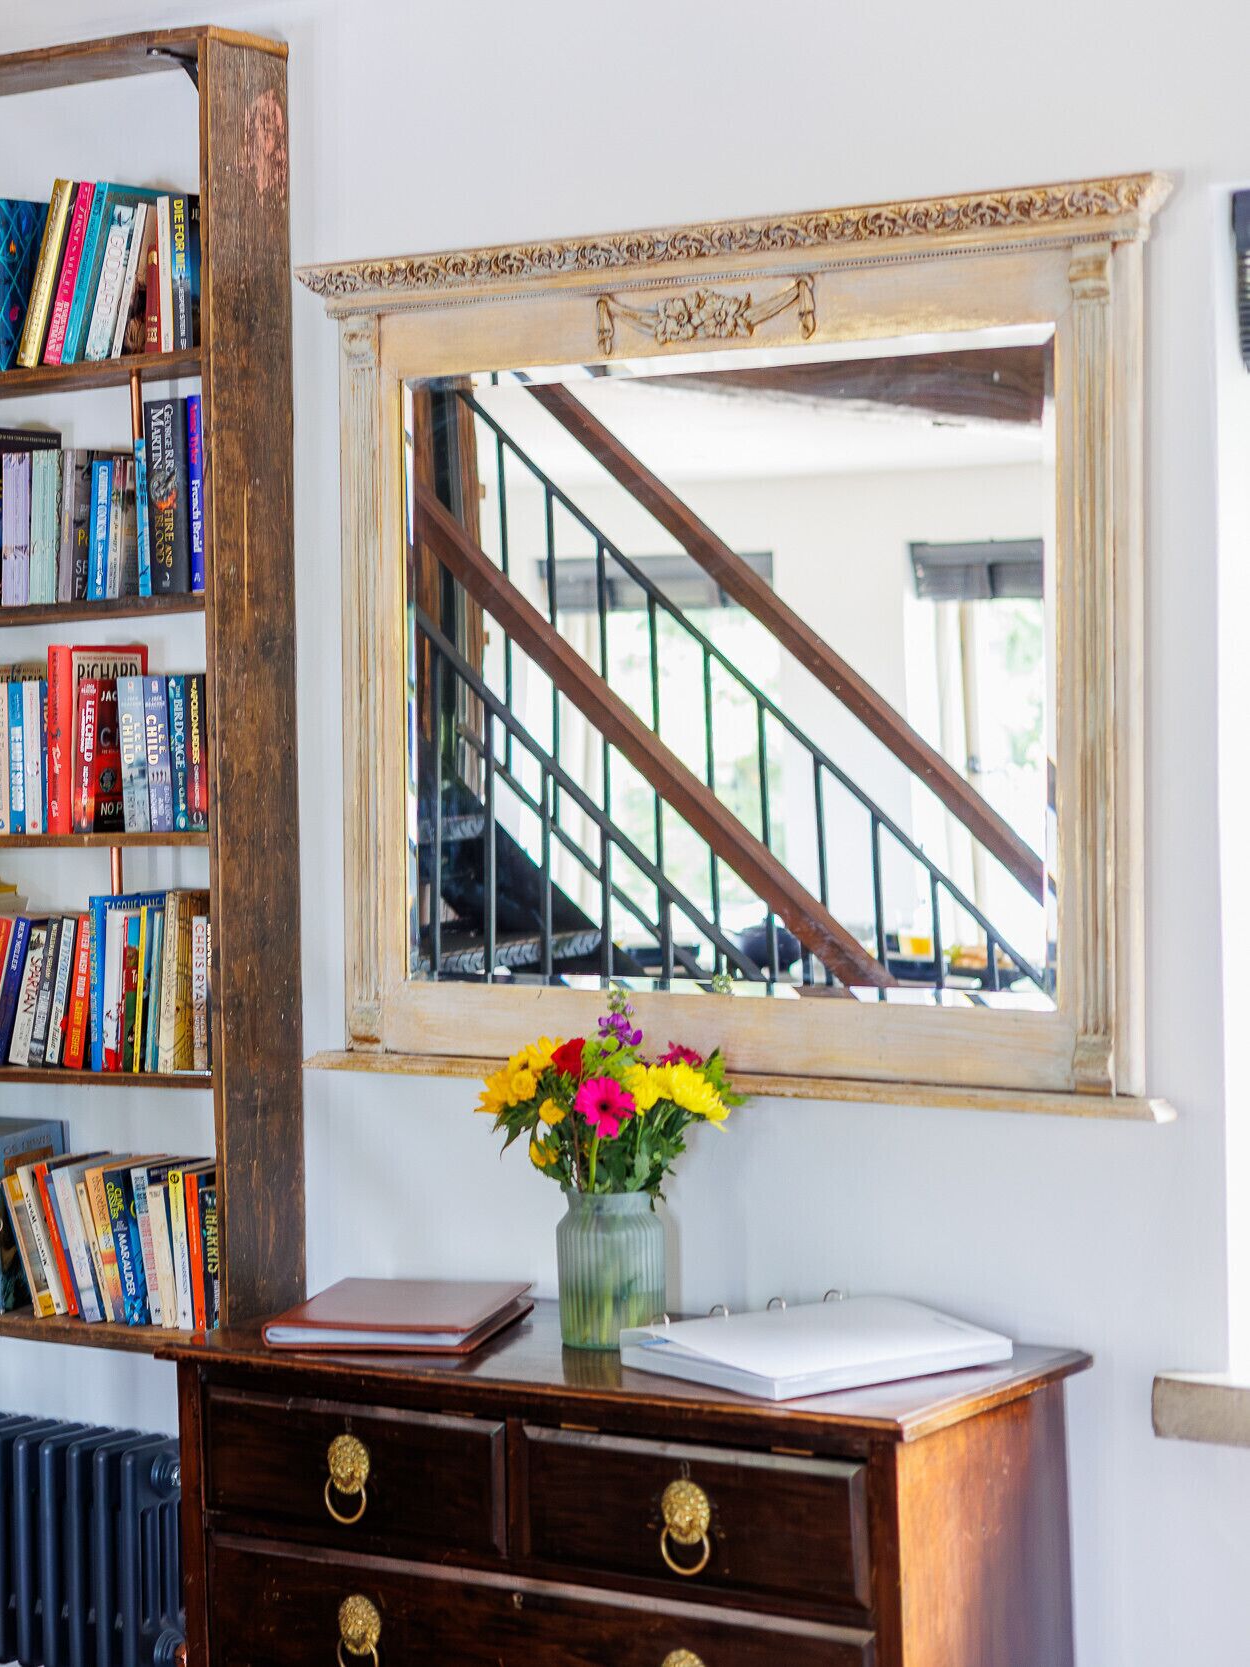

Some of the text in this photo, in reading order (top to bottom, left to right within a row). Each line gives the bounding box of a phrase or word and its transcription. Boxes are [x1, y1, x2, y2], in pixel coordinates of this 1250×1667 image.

[172, 199, 183, 221] DIE
[173, 223, 184, 250] FOR
[151, 407, 164, 469] MARTIN
[164, 404, 173, 447] GEORGE
[155, 511, 164, 563] BLOOD
[163, 509, 174, 542] FIRE
[191, 478, 202, 553] French Braid
[83, 700, 94, 761] LEE CHILD
[121, 713, 134, 764] CHILD
[133, 722, 142, 753] LEE
[145, 714, 158, 764] CHILD
[158, 723, 166, 754] LEE
[172, 698, 185, 769] BIRDCAGE
[100, 803, 114, 817] NO
[150, 788, 158, 826] TROUBLE
[26, 954, 41, 1013] SPARTAN
[195, 923, 204, 1011] CHRIS RYAN
[106, 1182, 118, 1220] CUSSLER
[114, 1187, 124, 1211] CLIVE
[116, 1232, 137, 1296] MARAUDER
[204, 1213, 220, 1273] HARRIS
